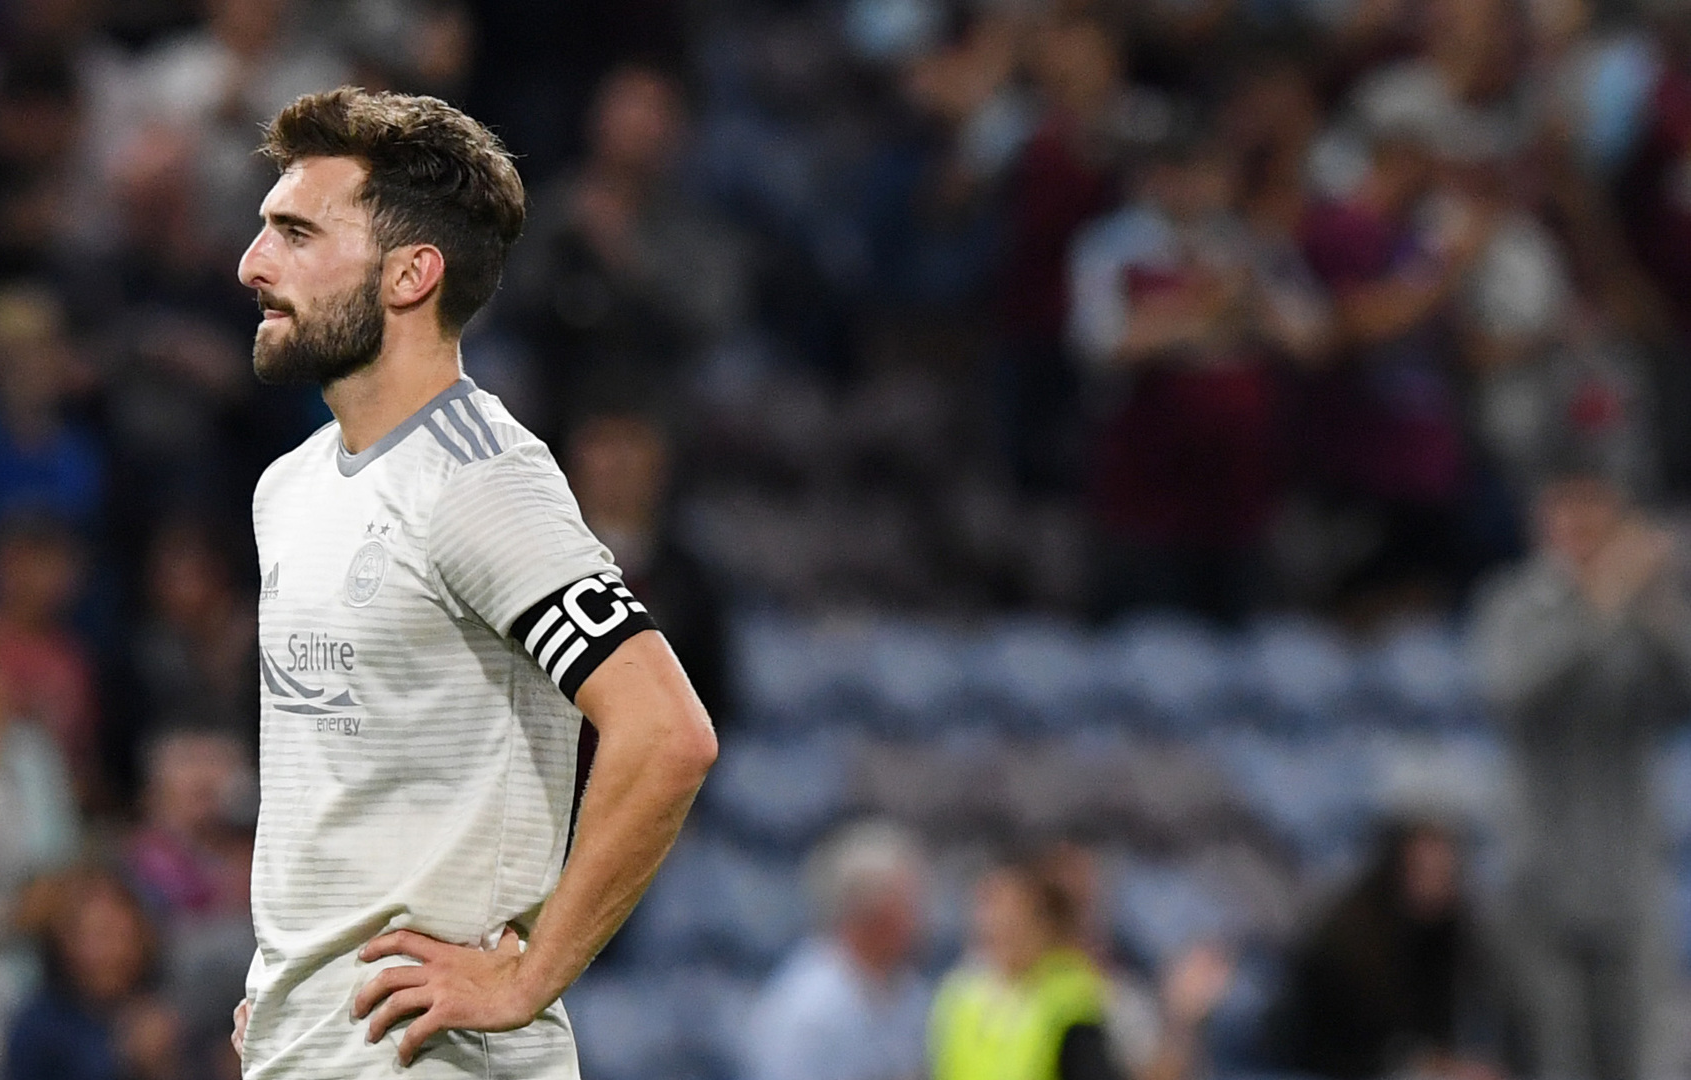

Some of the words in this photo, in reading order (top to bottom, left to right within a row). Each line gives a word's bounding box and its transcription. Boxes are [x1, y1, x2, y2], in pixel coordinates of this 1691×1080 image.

[563, 577, 629, 637] C
[287, 632, 354, 672] Saltire
[316, 717, 361, 736] energy
